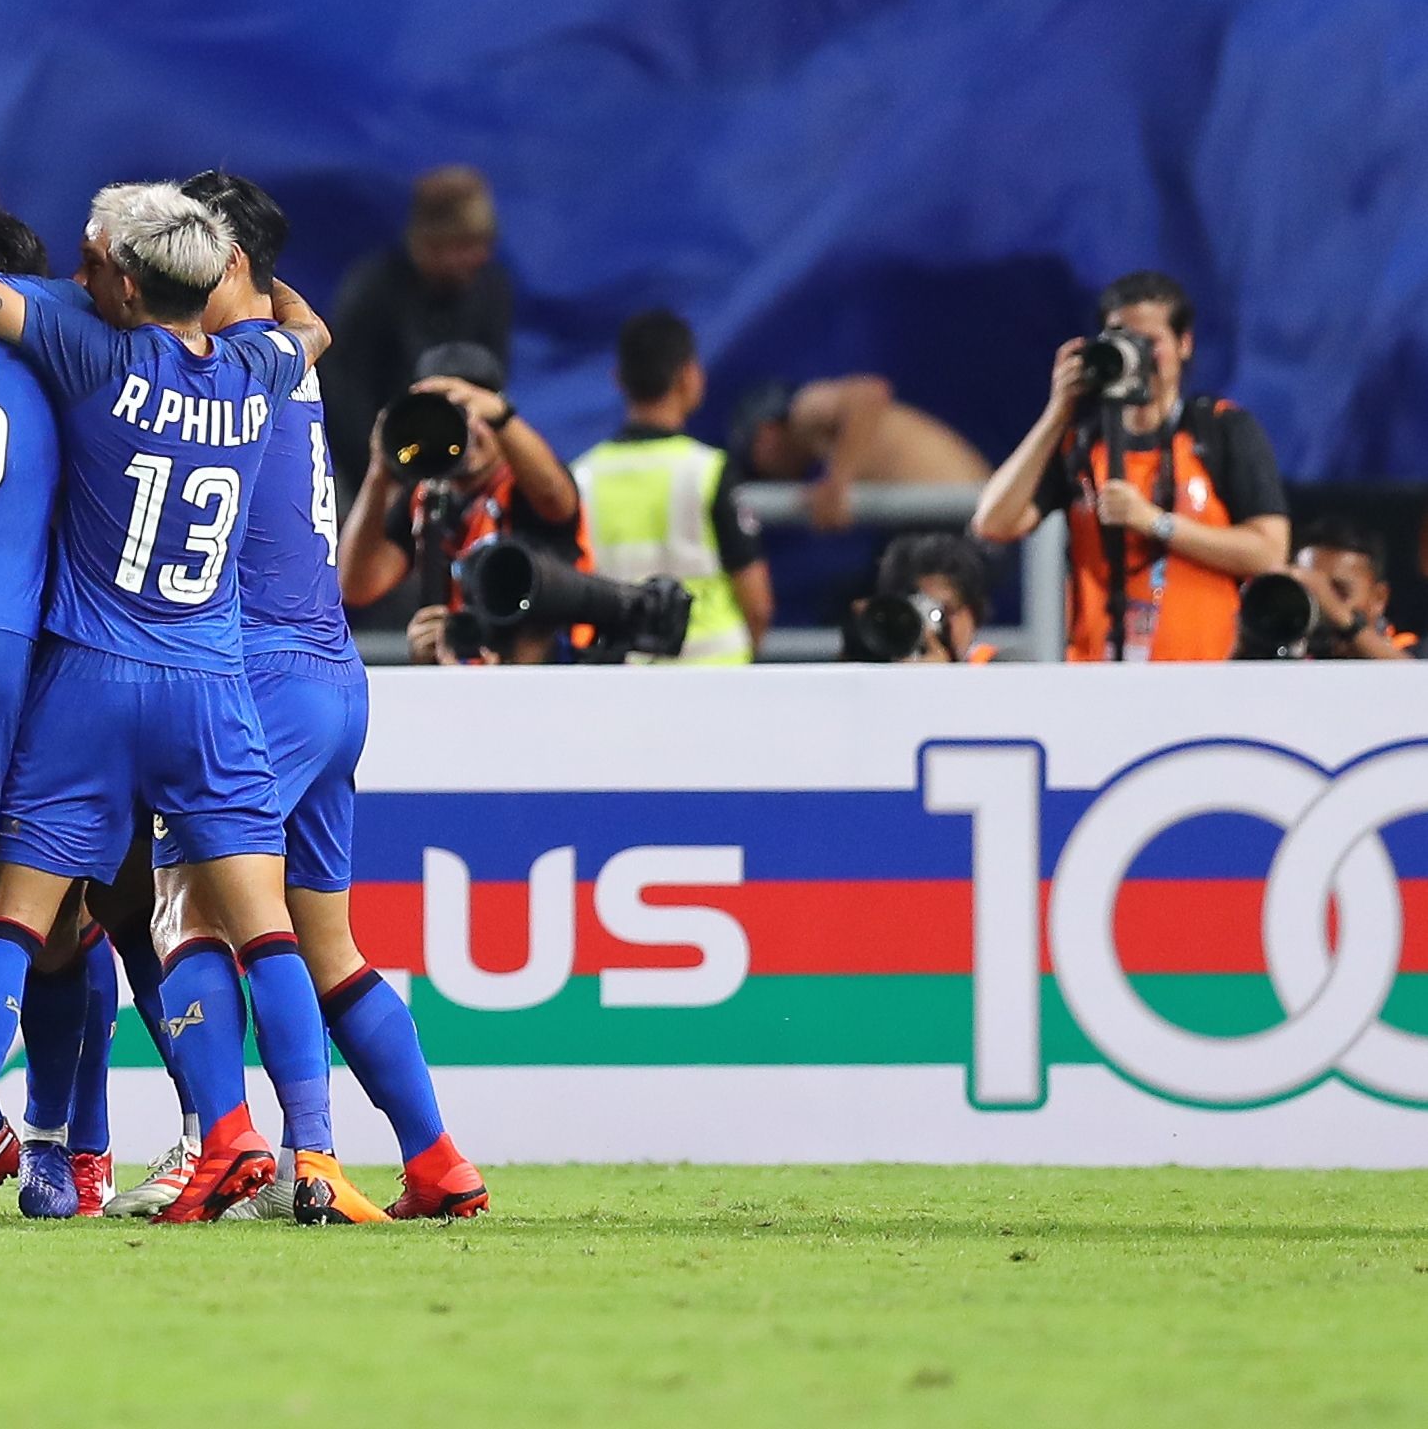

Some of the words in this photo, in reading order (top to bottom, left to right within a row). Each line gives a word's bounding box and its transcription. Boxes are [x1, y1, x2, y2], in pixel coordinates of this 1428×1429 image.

[112, 373, 269, 448] R.PHILIP
[114, 452, 241, 605] 13
[365, 845, 751, 1012] US
